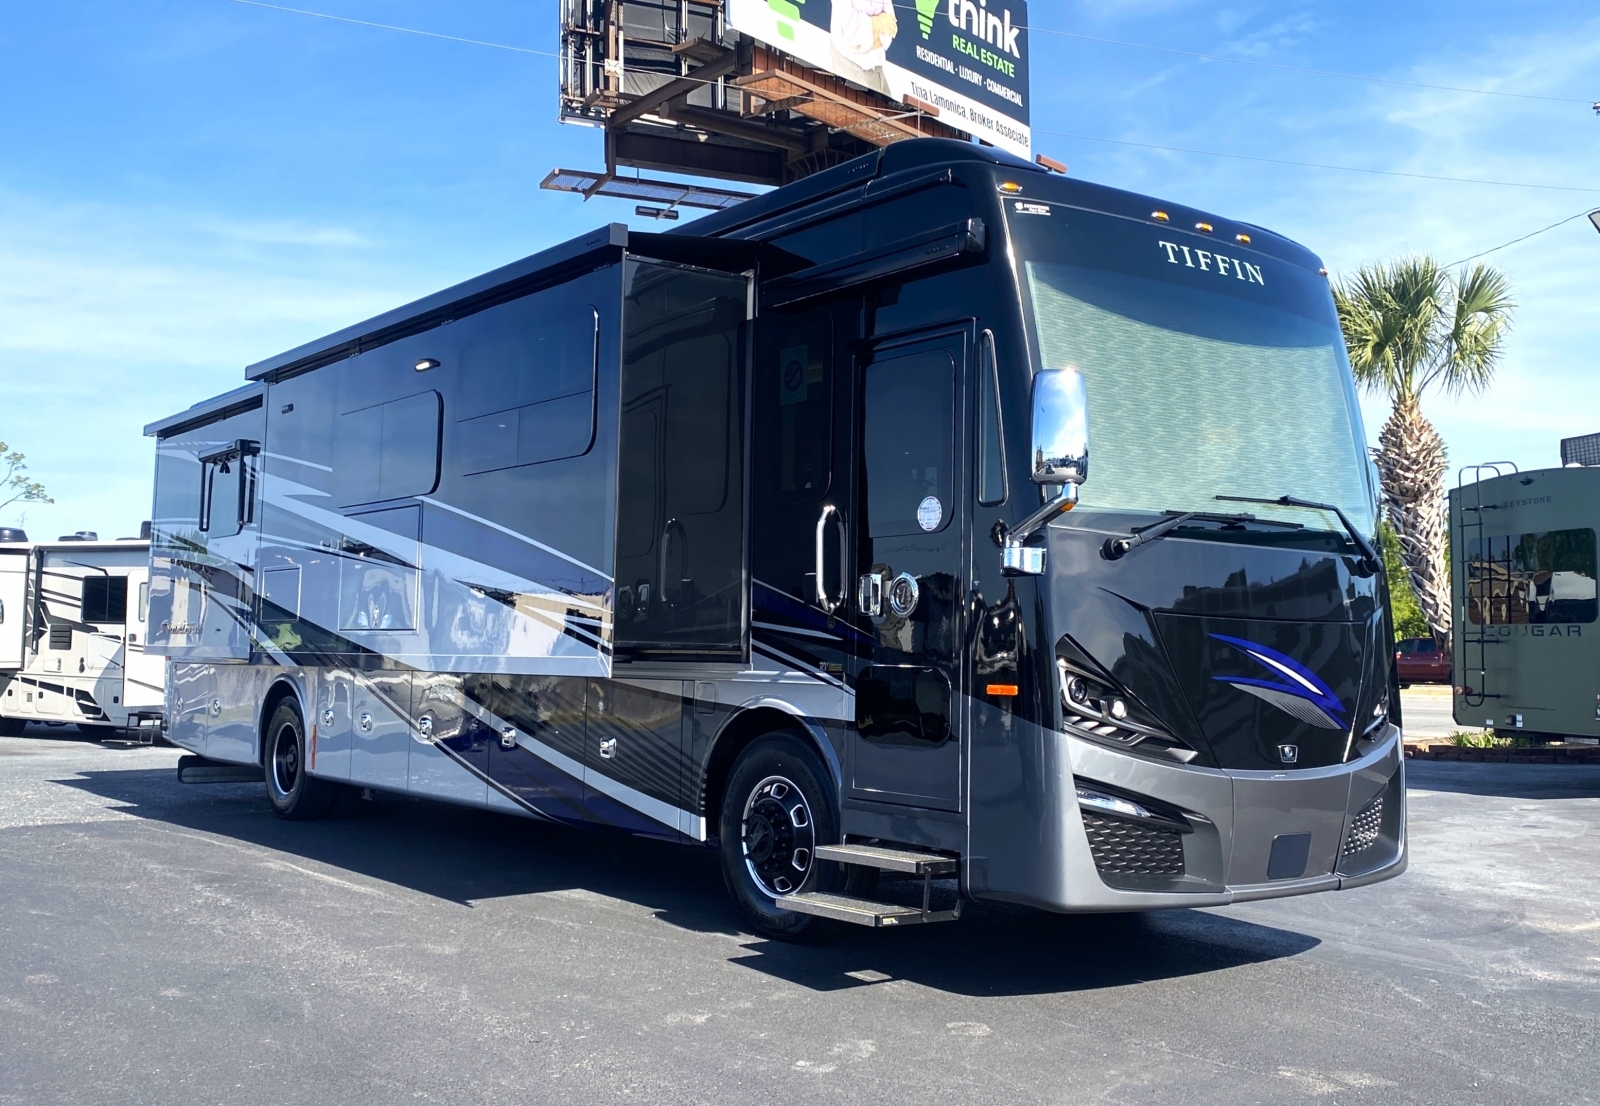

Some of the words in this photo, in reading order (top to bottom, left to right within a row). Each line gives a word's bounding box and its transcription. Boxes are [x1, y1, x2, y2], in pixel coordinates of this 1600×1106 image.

[948, 0, 1021, 58] think
[916, 45, 955, 74] RESIDENTIAL
[959, 65, 983, 87] LUXURY
[986, 79, 1024, 107] COMMERCIAL
[952, 34, 979, 60] REAL
[981, 48, 1015, 78] ESTATE
[911, 81, 928, 102] Tina
[970, 108, 994, 130] Broker
[996, 121, 1029, 147] Associate
[1159, 240, 1265, 286] TIFFIN
[1503, 495, 1553, 508] KEYSTONE
[1484, 625, 1582, 638] COUGAR
